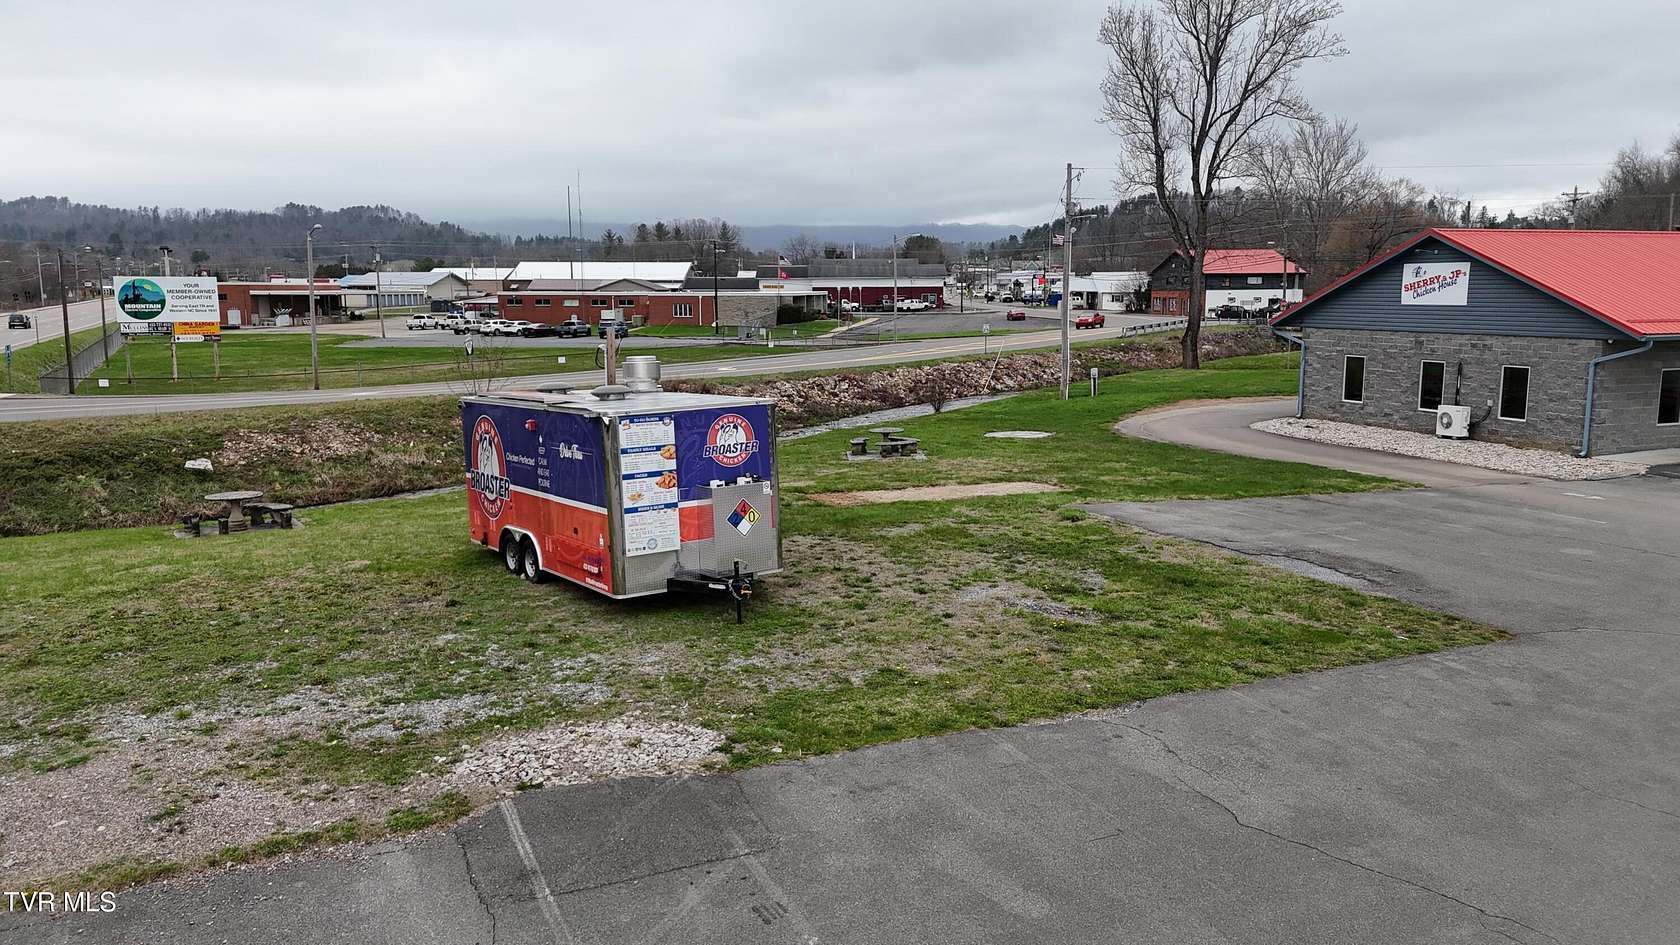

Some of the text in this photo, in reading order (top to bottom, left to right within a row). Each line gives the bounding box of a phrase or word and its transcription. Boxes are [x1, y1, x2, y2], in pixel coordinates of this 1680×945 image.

[1404, 275, 1442, 292] SHERRY
[1413, 279, 1457, 299] Chicken House
[715, 416, 746, 430] GENUINE
[704, 441, 759, 457] BROASTER
[718, 452, 748, 464] CHICKEN
[471, 469, 510, 499] BROASTER
[740, 502, 747, 514] 4
[748, 510, 756, 523] 0
